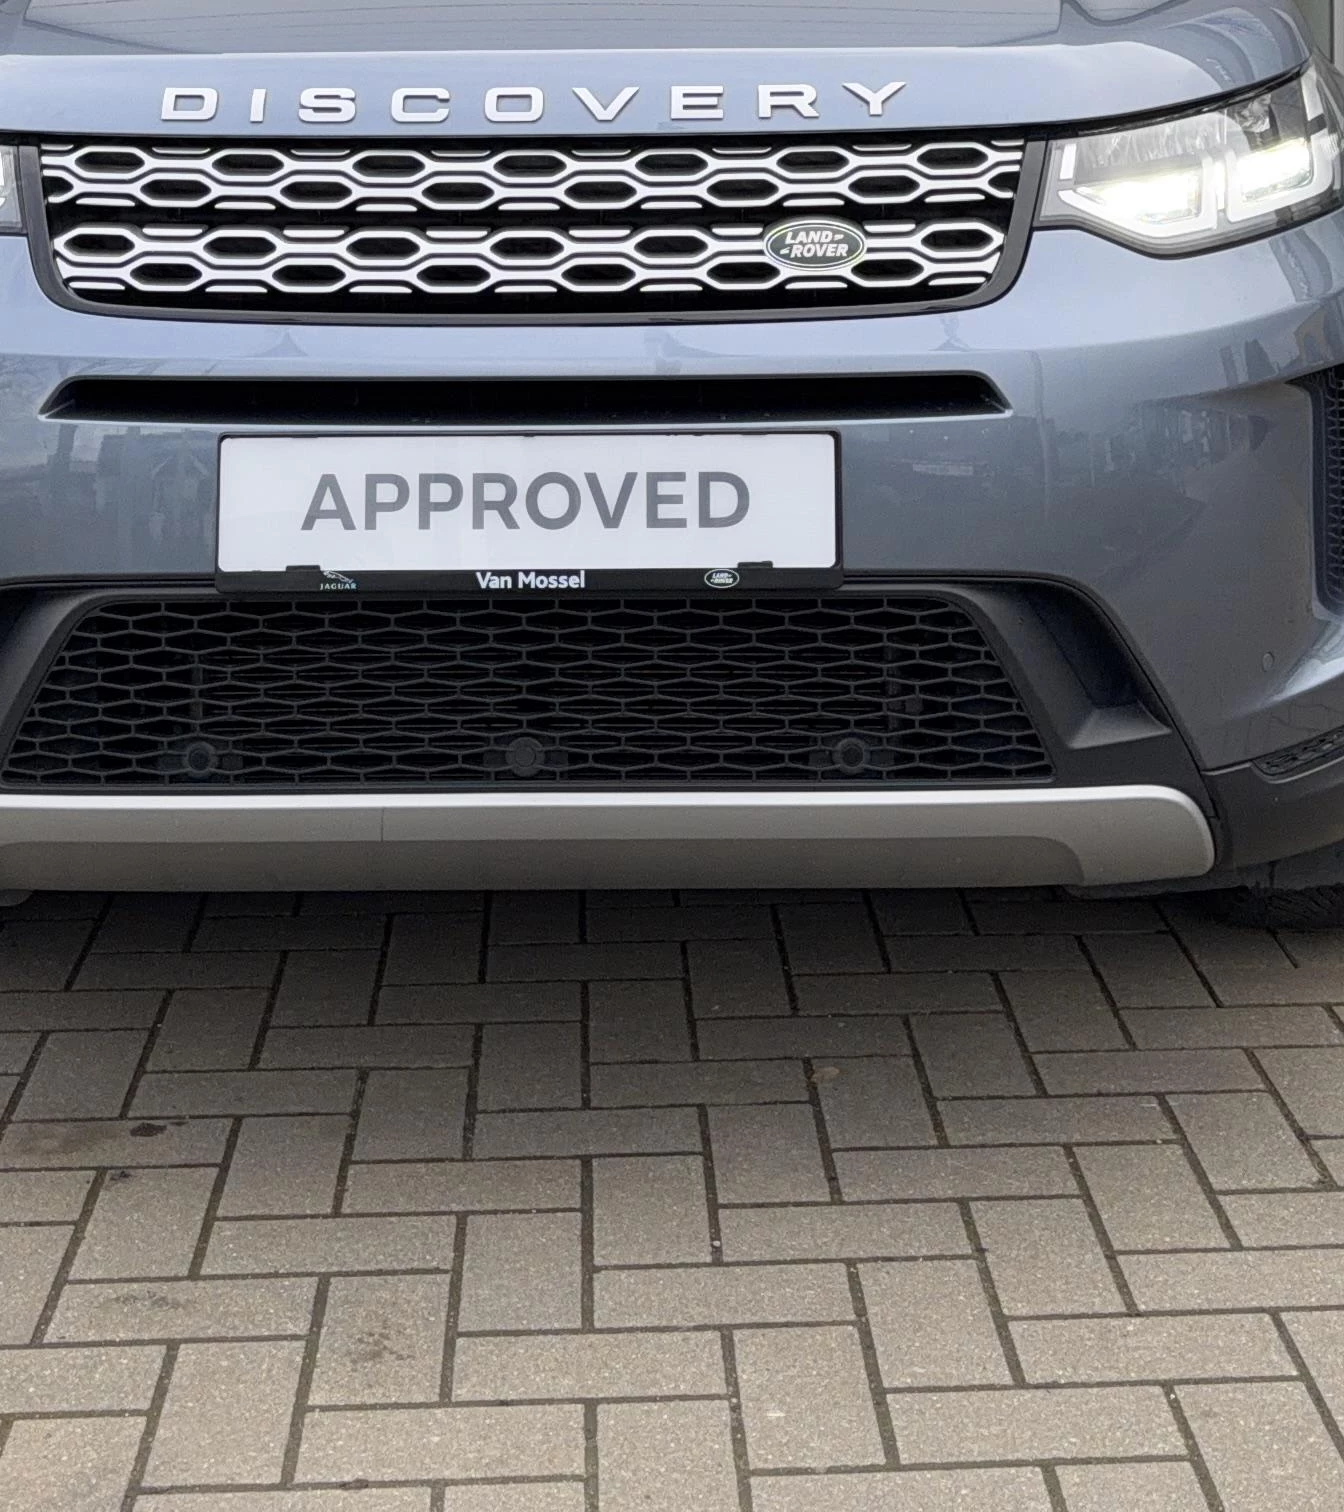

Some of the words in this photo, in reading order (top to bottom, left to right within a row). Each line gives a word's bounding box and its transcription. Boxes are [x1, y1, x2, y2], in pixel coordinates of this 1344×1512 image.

[160, 82, 907, 122] DISCOVERY
[785, 230, 833, 245] LAND
[790, 243, 849, 258] ROVER
[300, 471, 750, 531] APPROVED
[319, 582, 357, 591] JAGUAR
[475, 571, 513, 589] Van
[517, 569, 586, 589] Mossel
